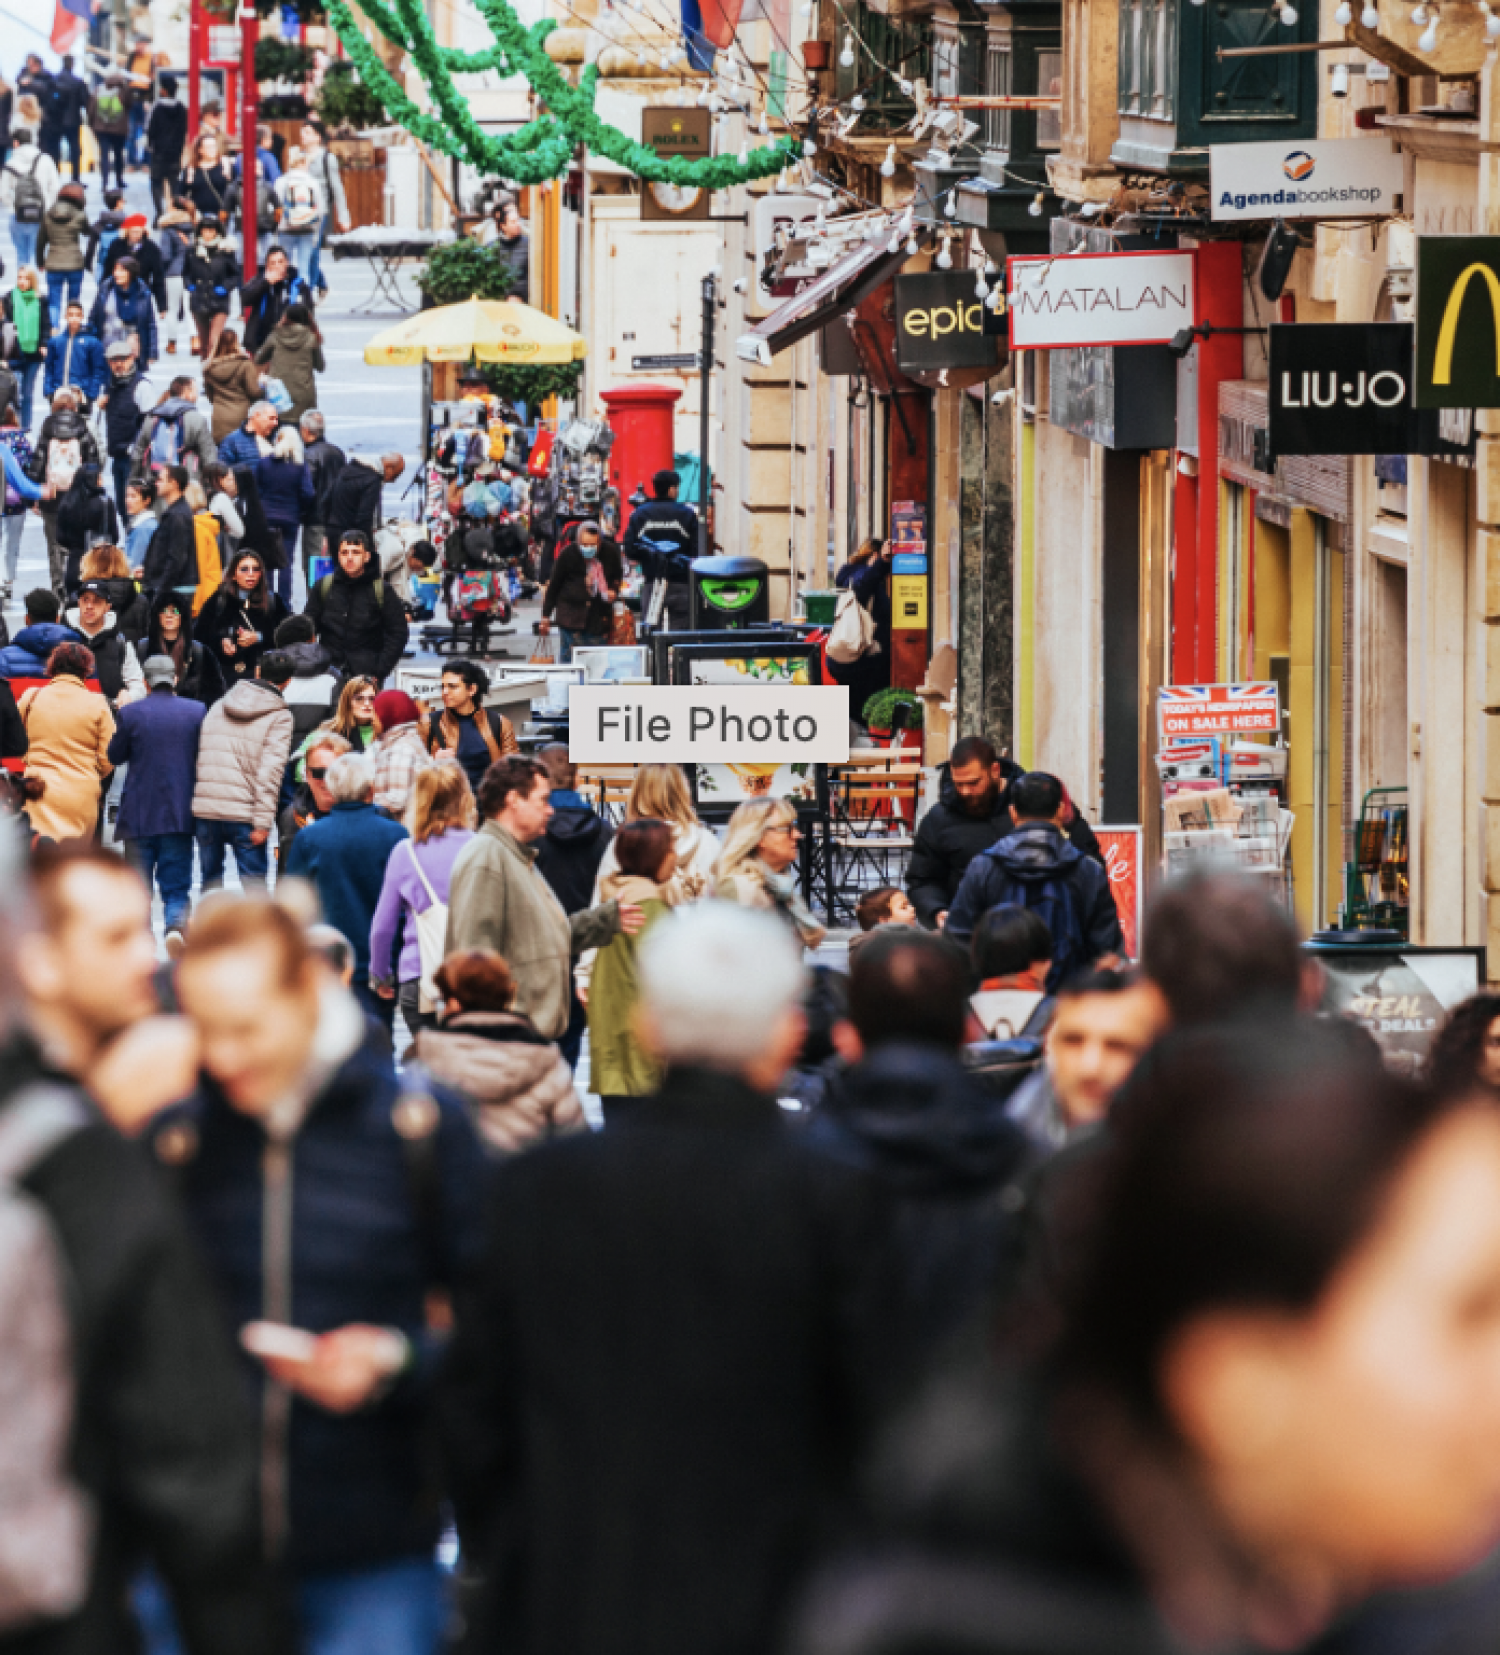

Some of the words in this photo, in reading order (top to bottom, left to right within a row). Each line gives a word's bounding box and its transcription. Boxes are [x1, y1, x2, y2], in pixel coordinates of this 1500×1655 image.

[1020, 284, 1187, 315] MATALAN
[903, 299, 983, 341] epic
[1167, 718, 1189, 732] ON
[1191, 716, 1230, 730] SALE
[1232, 712, 1273, 728] HERE
